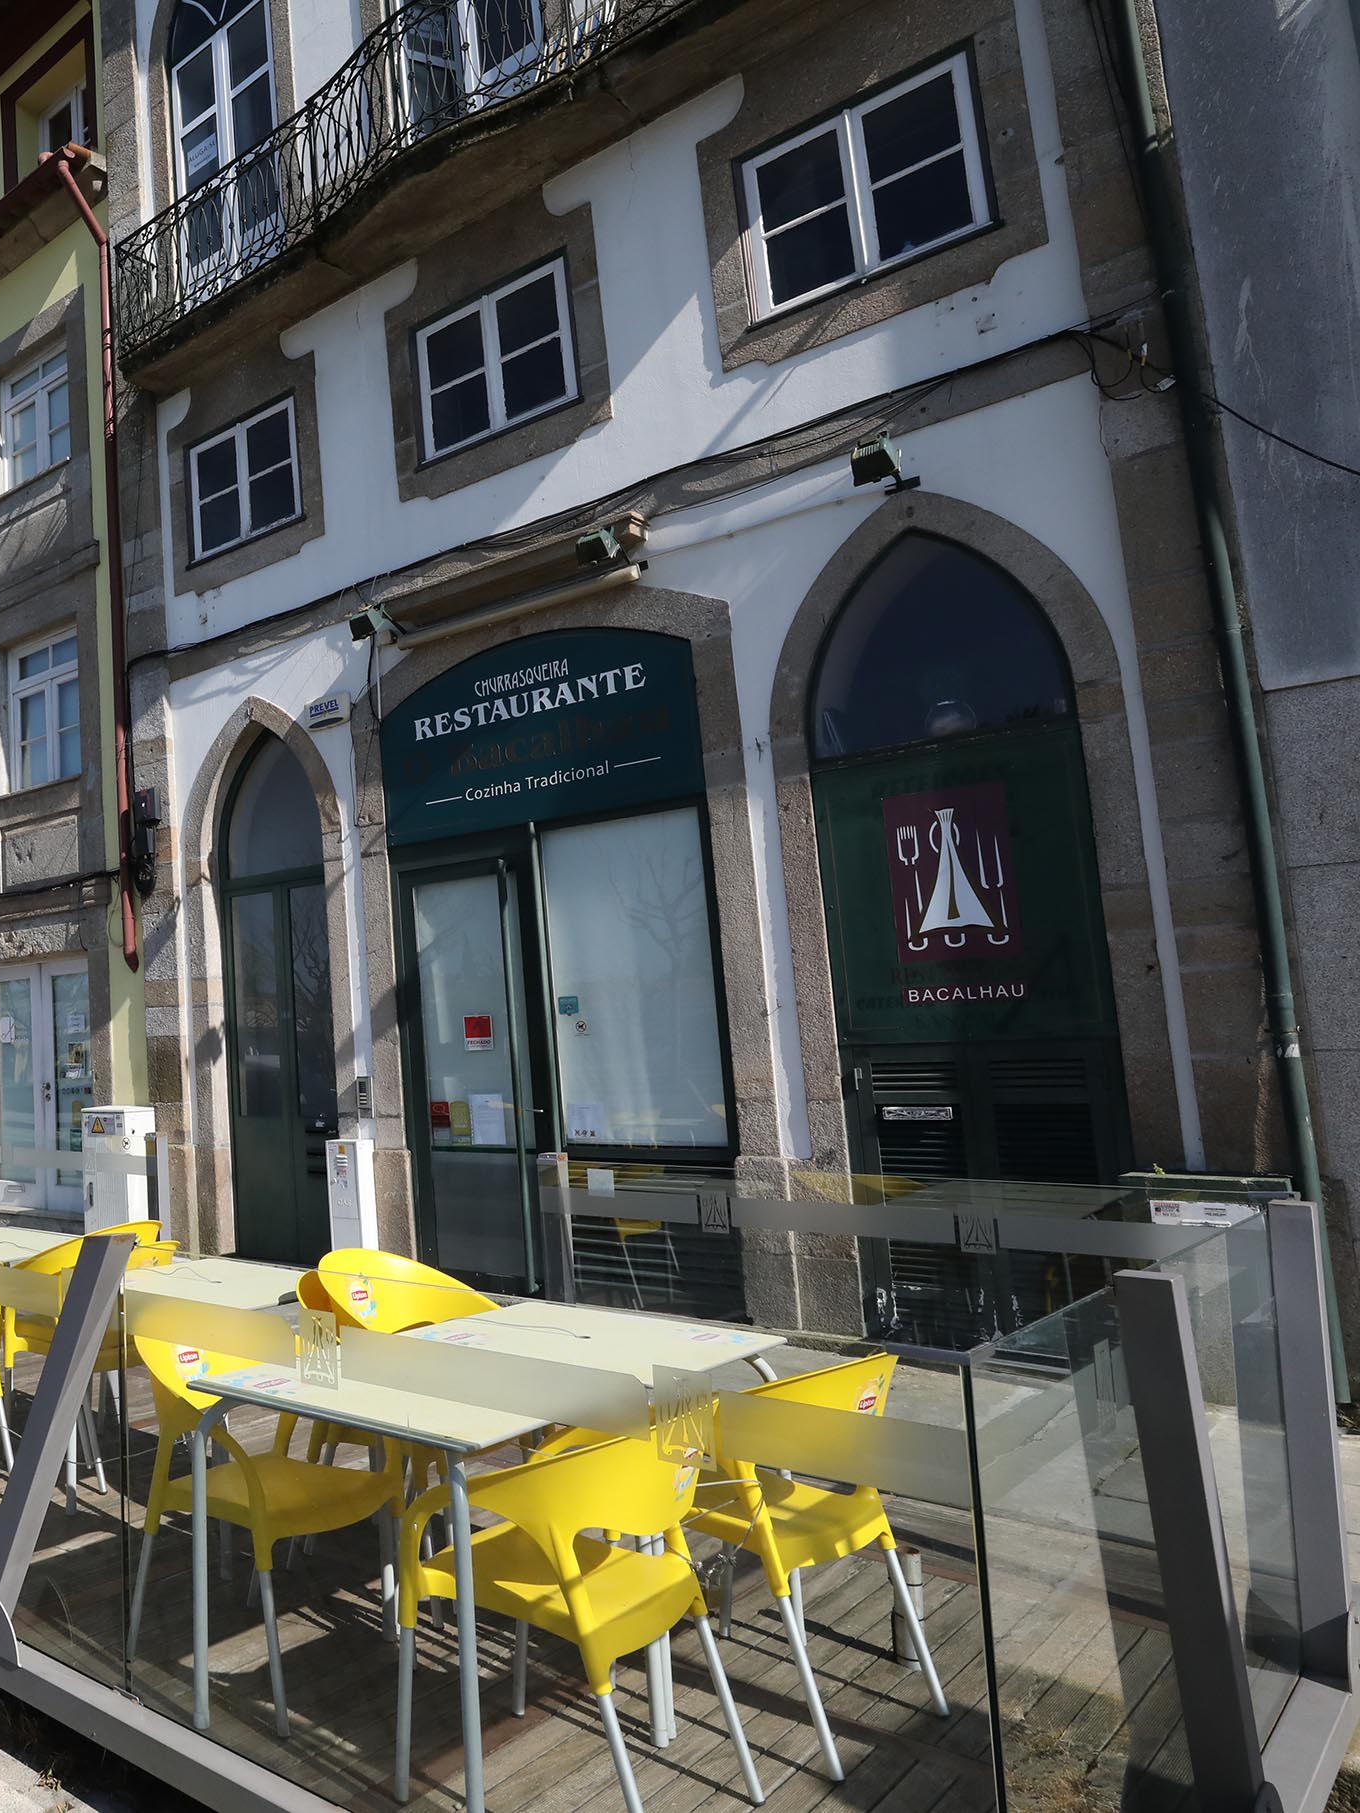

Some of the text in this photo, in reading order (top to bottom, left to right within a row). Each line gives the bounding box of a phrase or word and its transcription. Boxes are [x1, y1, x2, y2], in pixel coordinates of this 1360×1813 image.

[474, 658, 570, 698] CHURRASQUEIRA
[309, 699, 339, 714] PREVEL
[413, 662, 647, 742] RESTAURANTE
[465, 760, 609, 801] Cozinha Tradicional
[908, 983, 1025, 1003] BACALHAU
[352, 1291, 368, 1300] Lipton
[179, 1351, 198, 1363] Lipton
